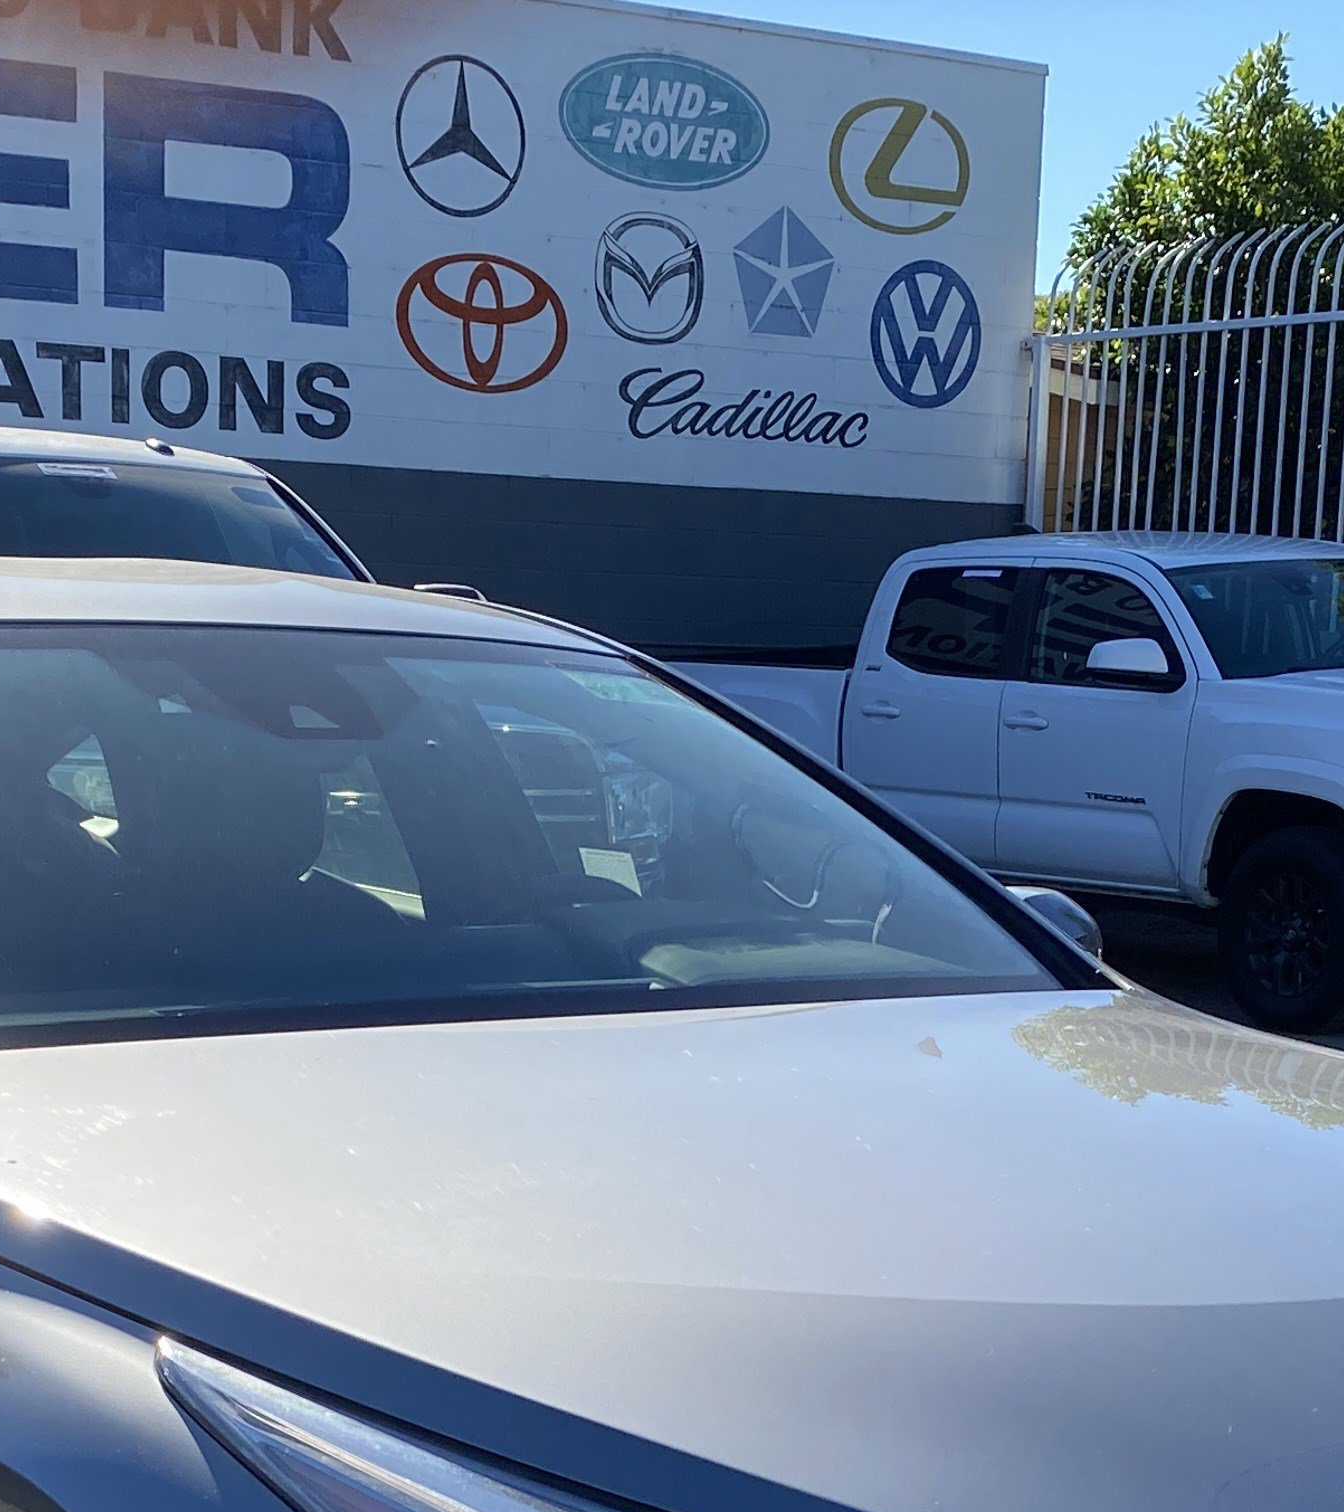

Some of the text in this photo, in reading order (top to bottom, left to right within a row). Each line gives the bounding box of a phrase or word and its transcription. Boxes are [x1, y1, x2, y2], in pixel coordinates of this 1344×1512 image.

[604, 74, 706, 119] LAND
[613, 117, 737, 165] ROVER
[618, 367, 869, 448] Cadillac
